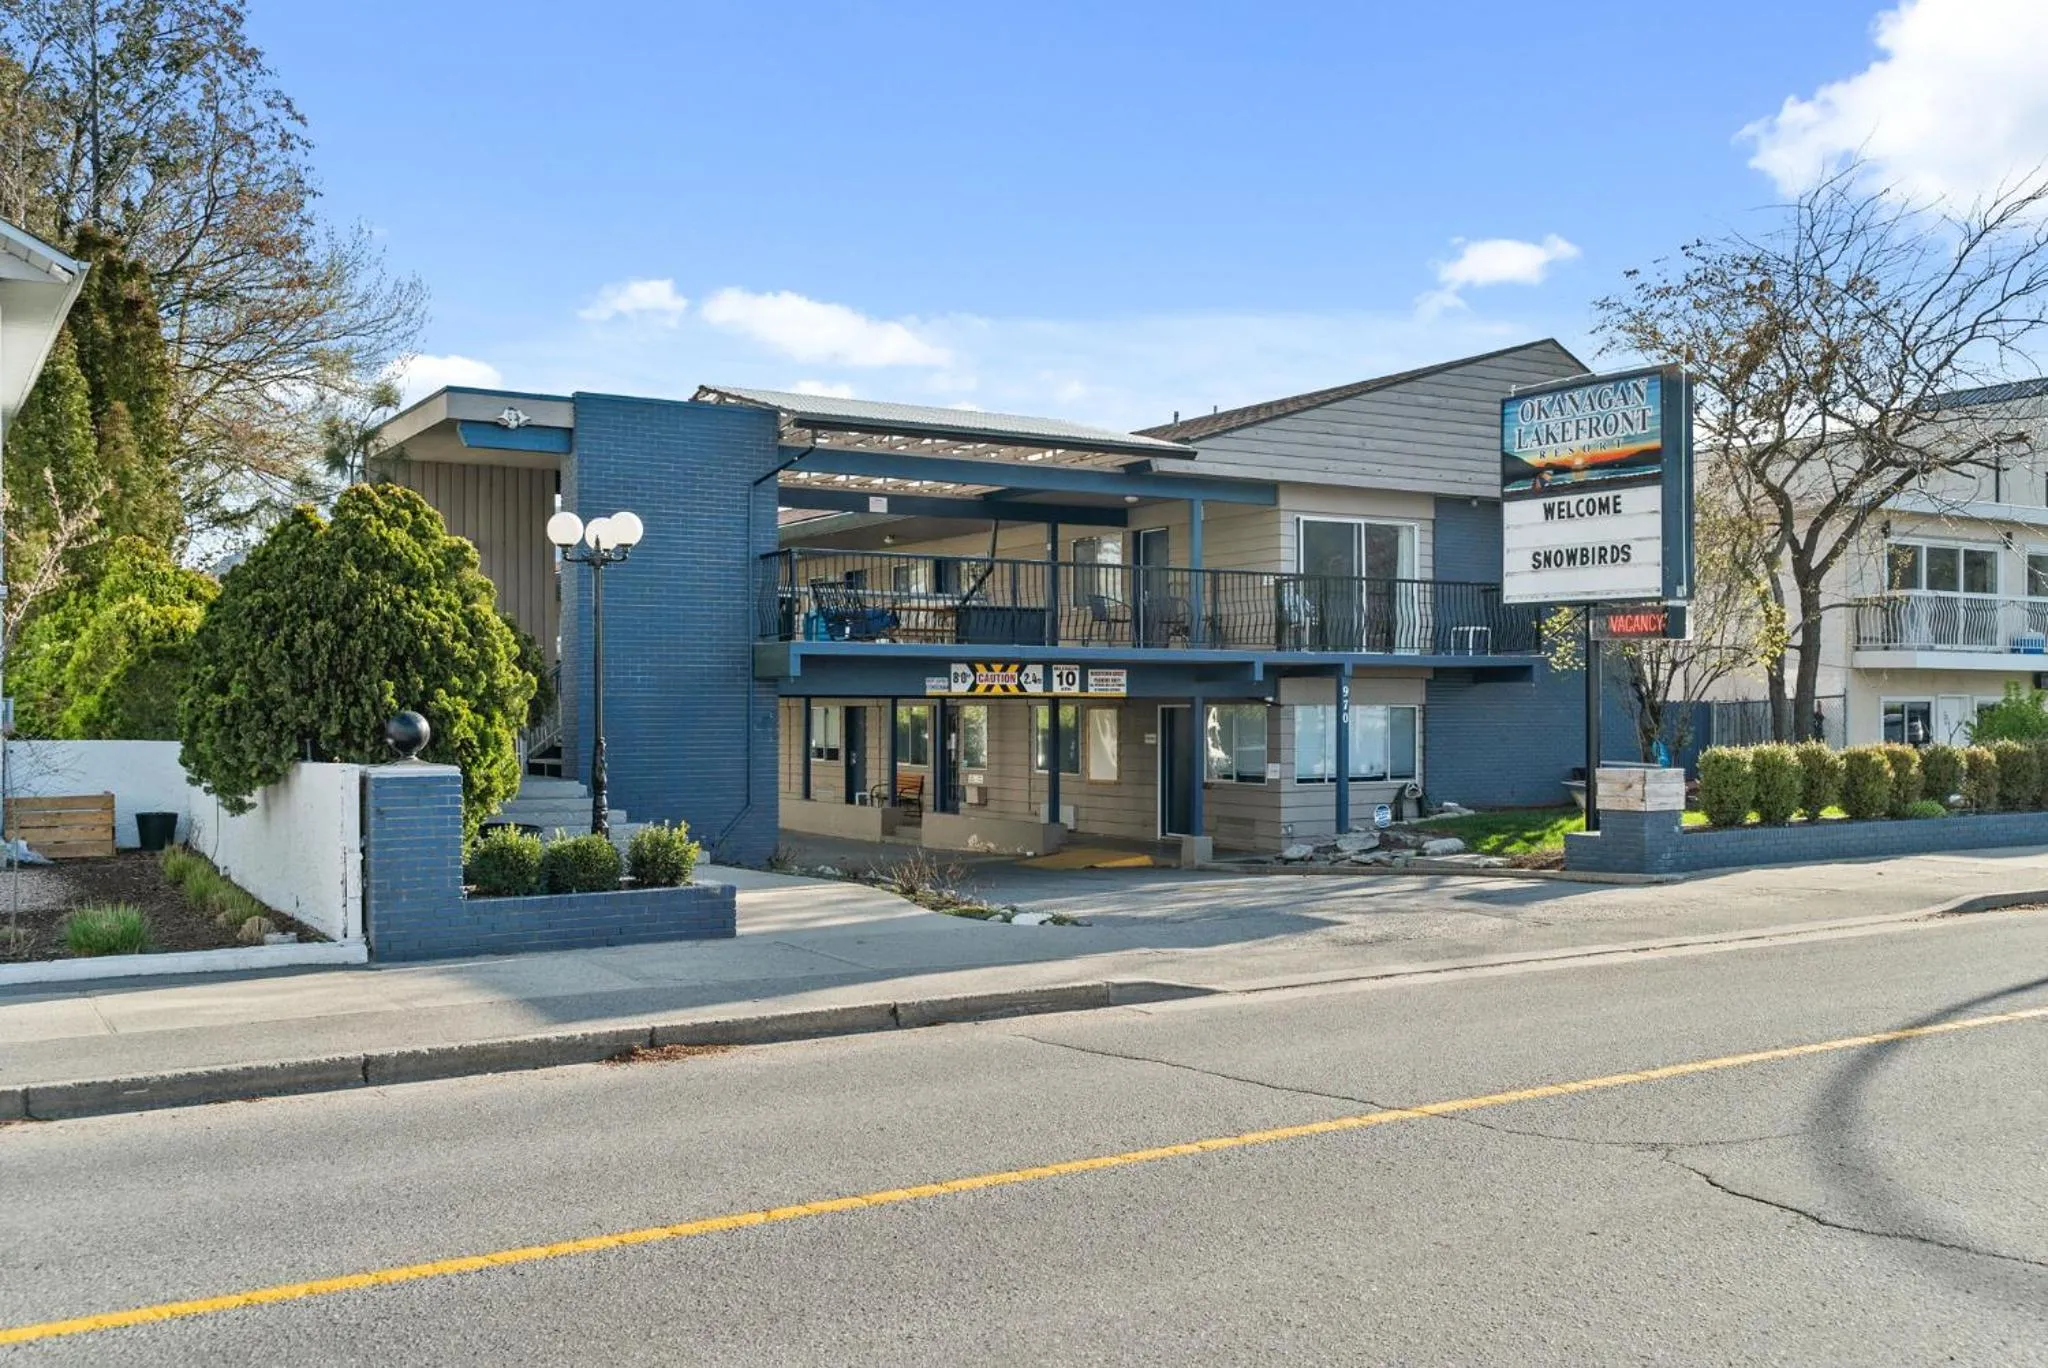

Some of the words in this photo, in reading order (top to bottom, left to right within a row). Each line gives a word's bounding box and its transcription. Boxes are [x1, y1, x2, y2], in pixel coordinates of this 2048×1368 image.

[1519, 379, 1649, 425] OKANAGAN
[1515, 406, 1652, 451] LAKEFRONT
[1539, 438, 1624, 459] RESORT
[1543, 495, 1622, 521] WELCOME
[1532, 544, 1632, 570] SNOWBIRDS
[1609, 613, 1663, 633] VACANCY
[978, 672, 1017, 684] CAUTION
[1056, 671, 1076, 686] 10
